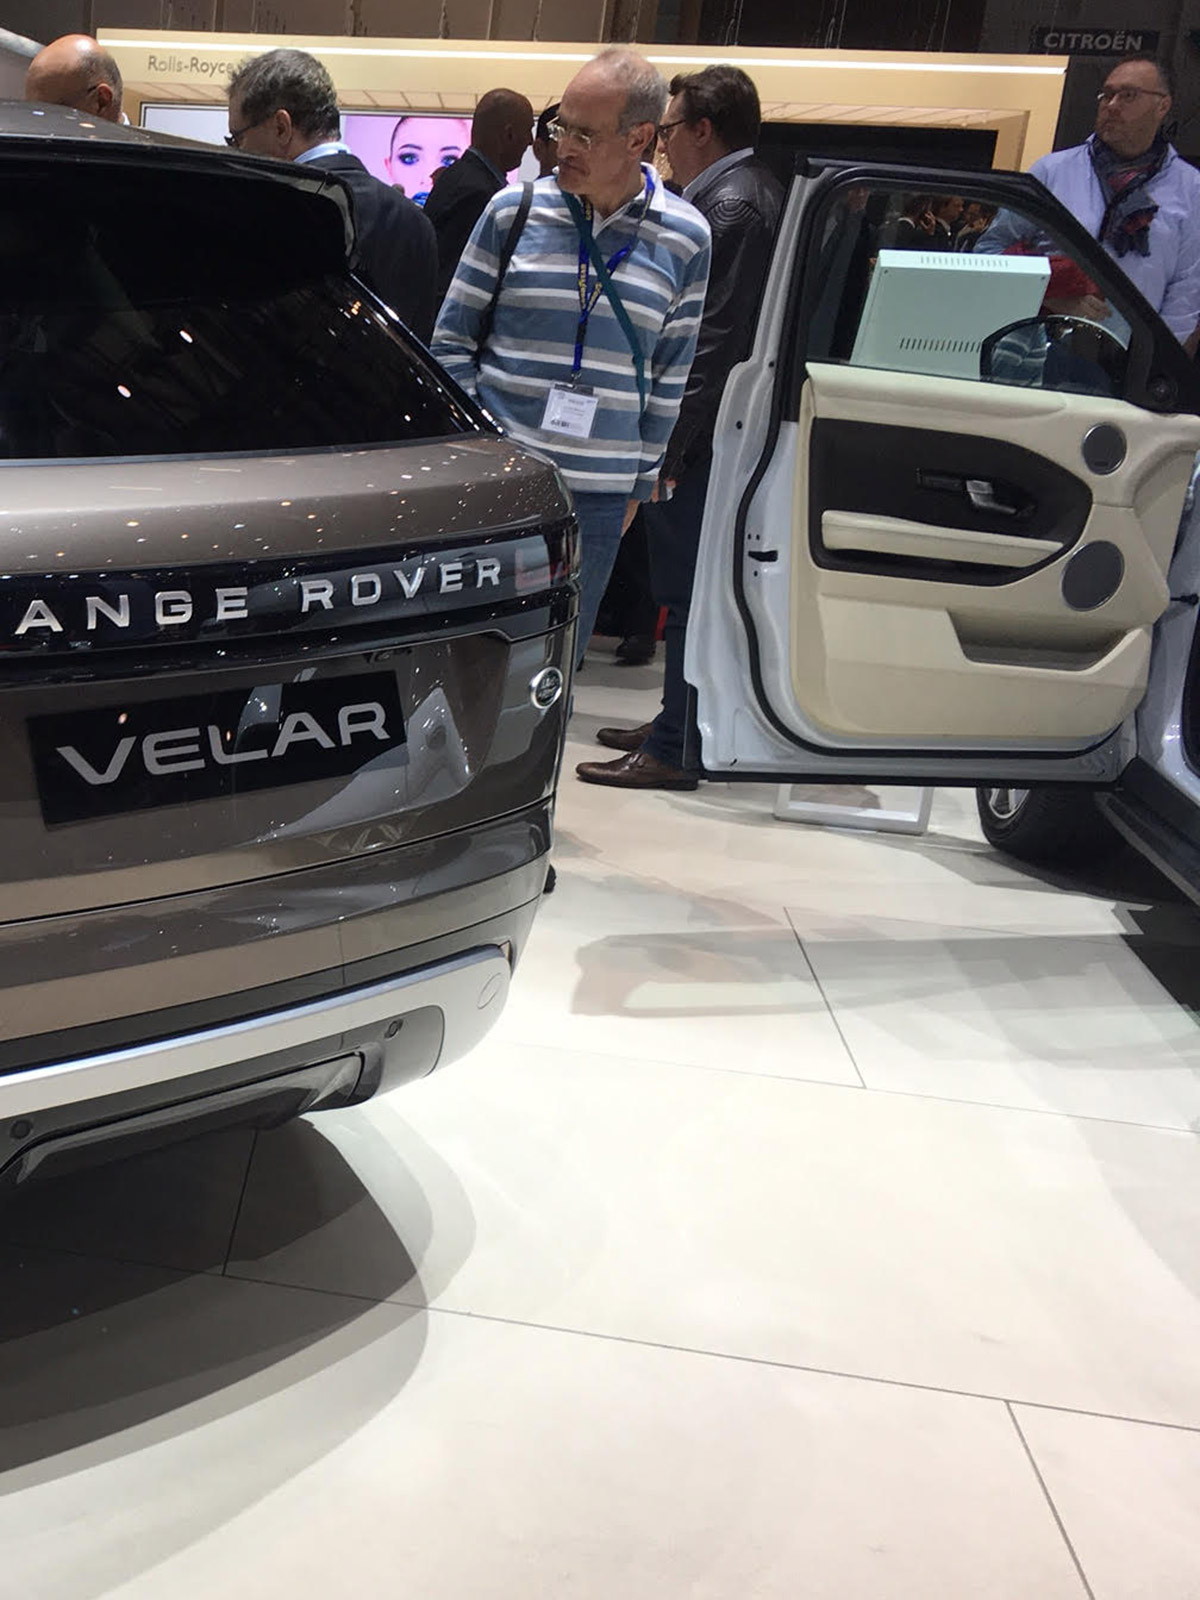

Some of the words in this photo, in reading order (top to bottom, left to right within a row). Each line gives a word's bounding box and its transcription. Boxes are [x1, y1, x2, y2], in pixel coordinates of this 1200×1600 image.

[1043, 31, 1143, 51] CITROËN
[147, 55, 236, 78] Rolls-Royce
[300, 557, 501, 612] ROVER
[56, 701, 391, 786] VELAR
